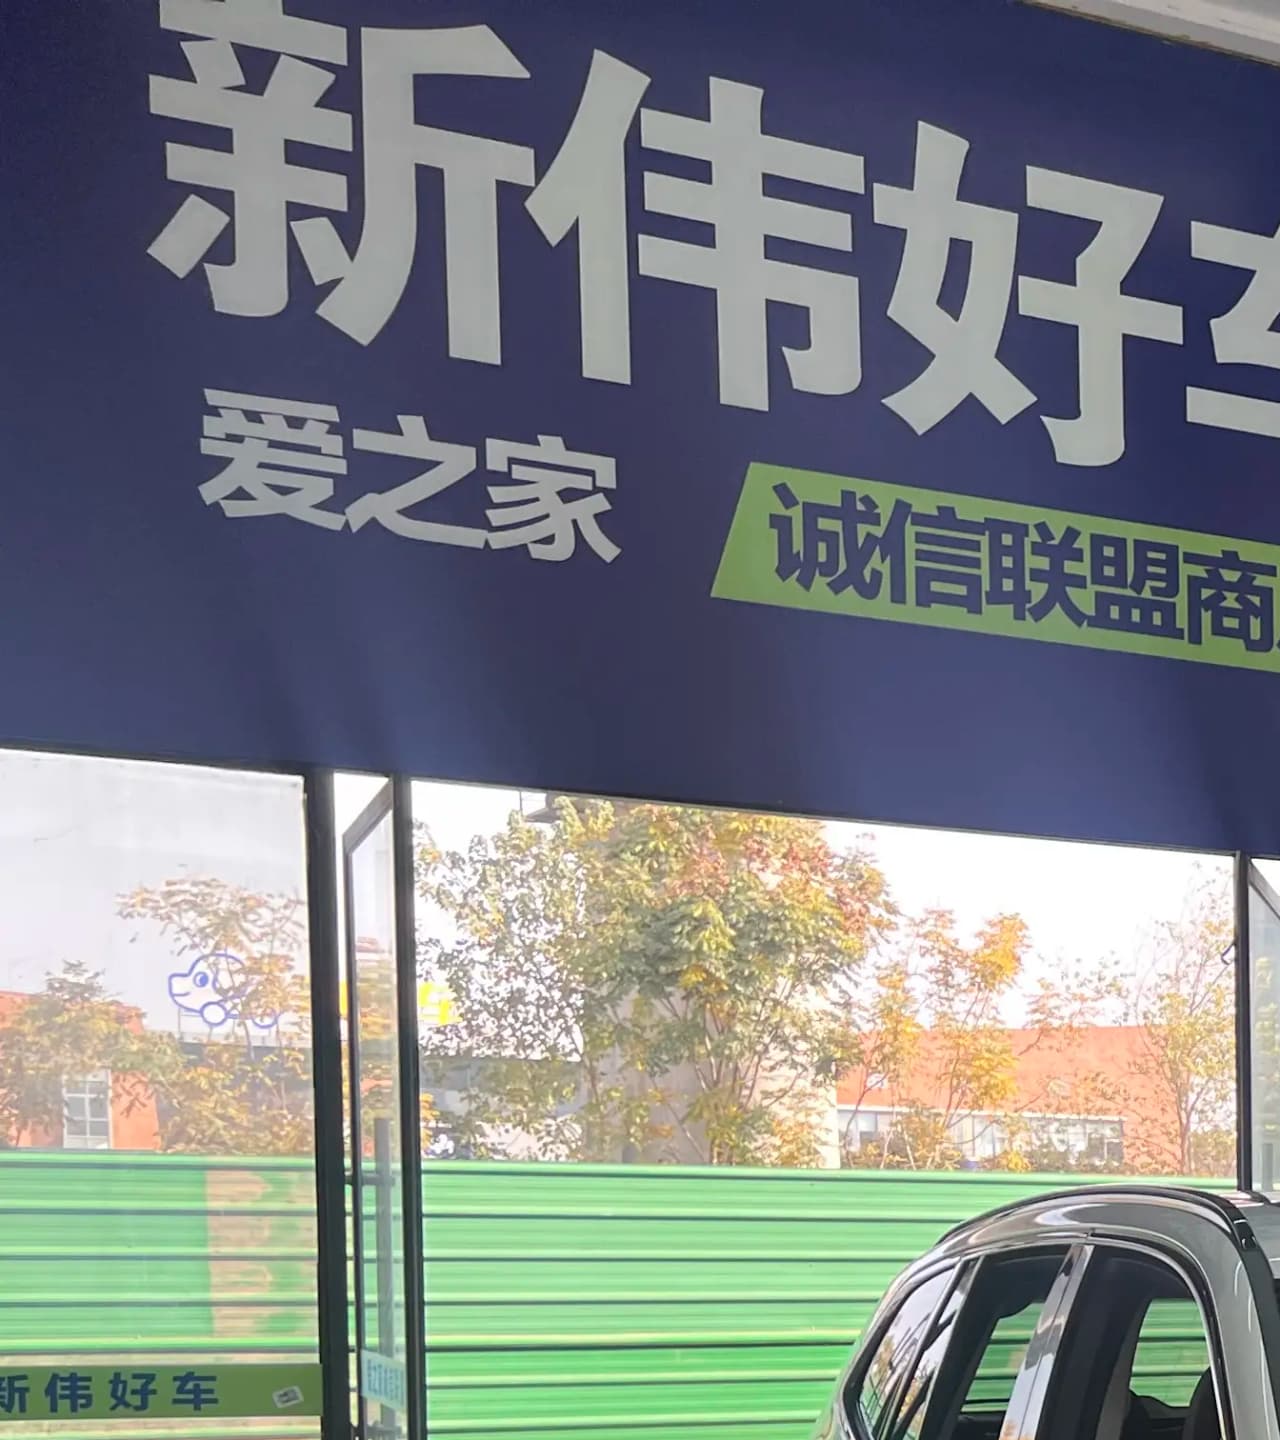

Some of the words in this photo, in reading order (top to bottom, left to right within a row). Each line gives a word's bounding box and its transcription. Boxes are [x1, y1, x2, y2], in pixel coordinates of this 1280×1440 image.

[198, 388, 622, 563] 爱之家
[0, 1372, 219, 1413] 新伟好车
